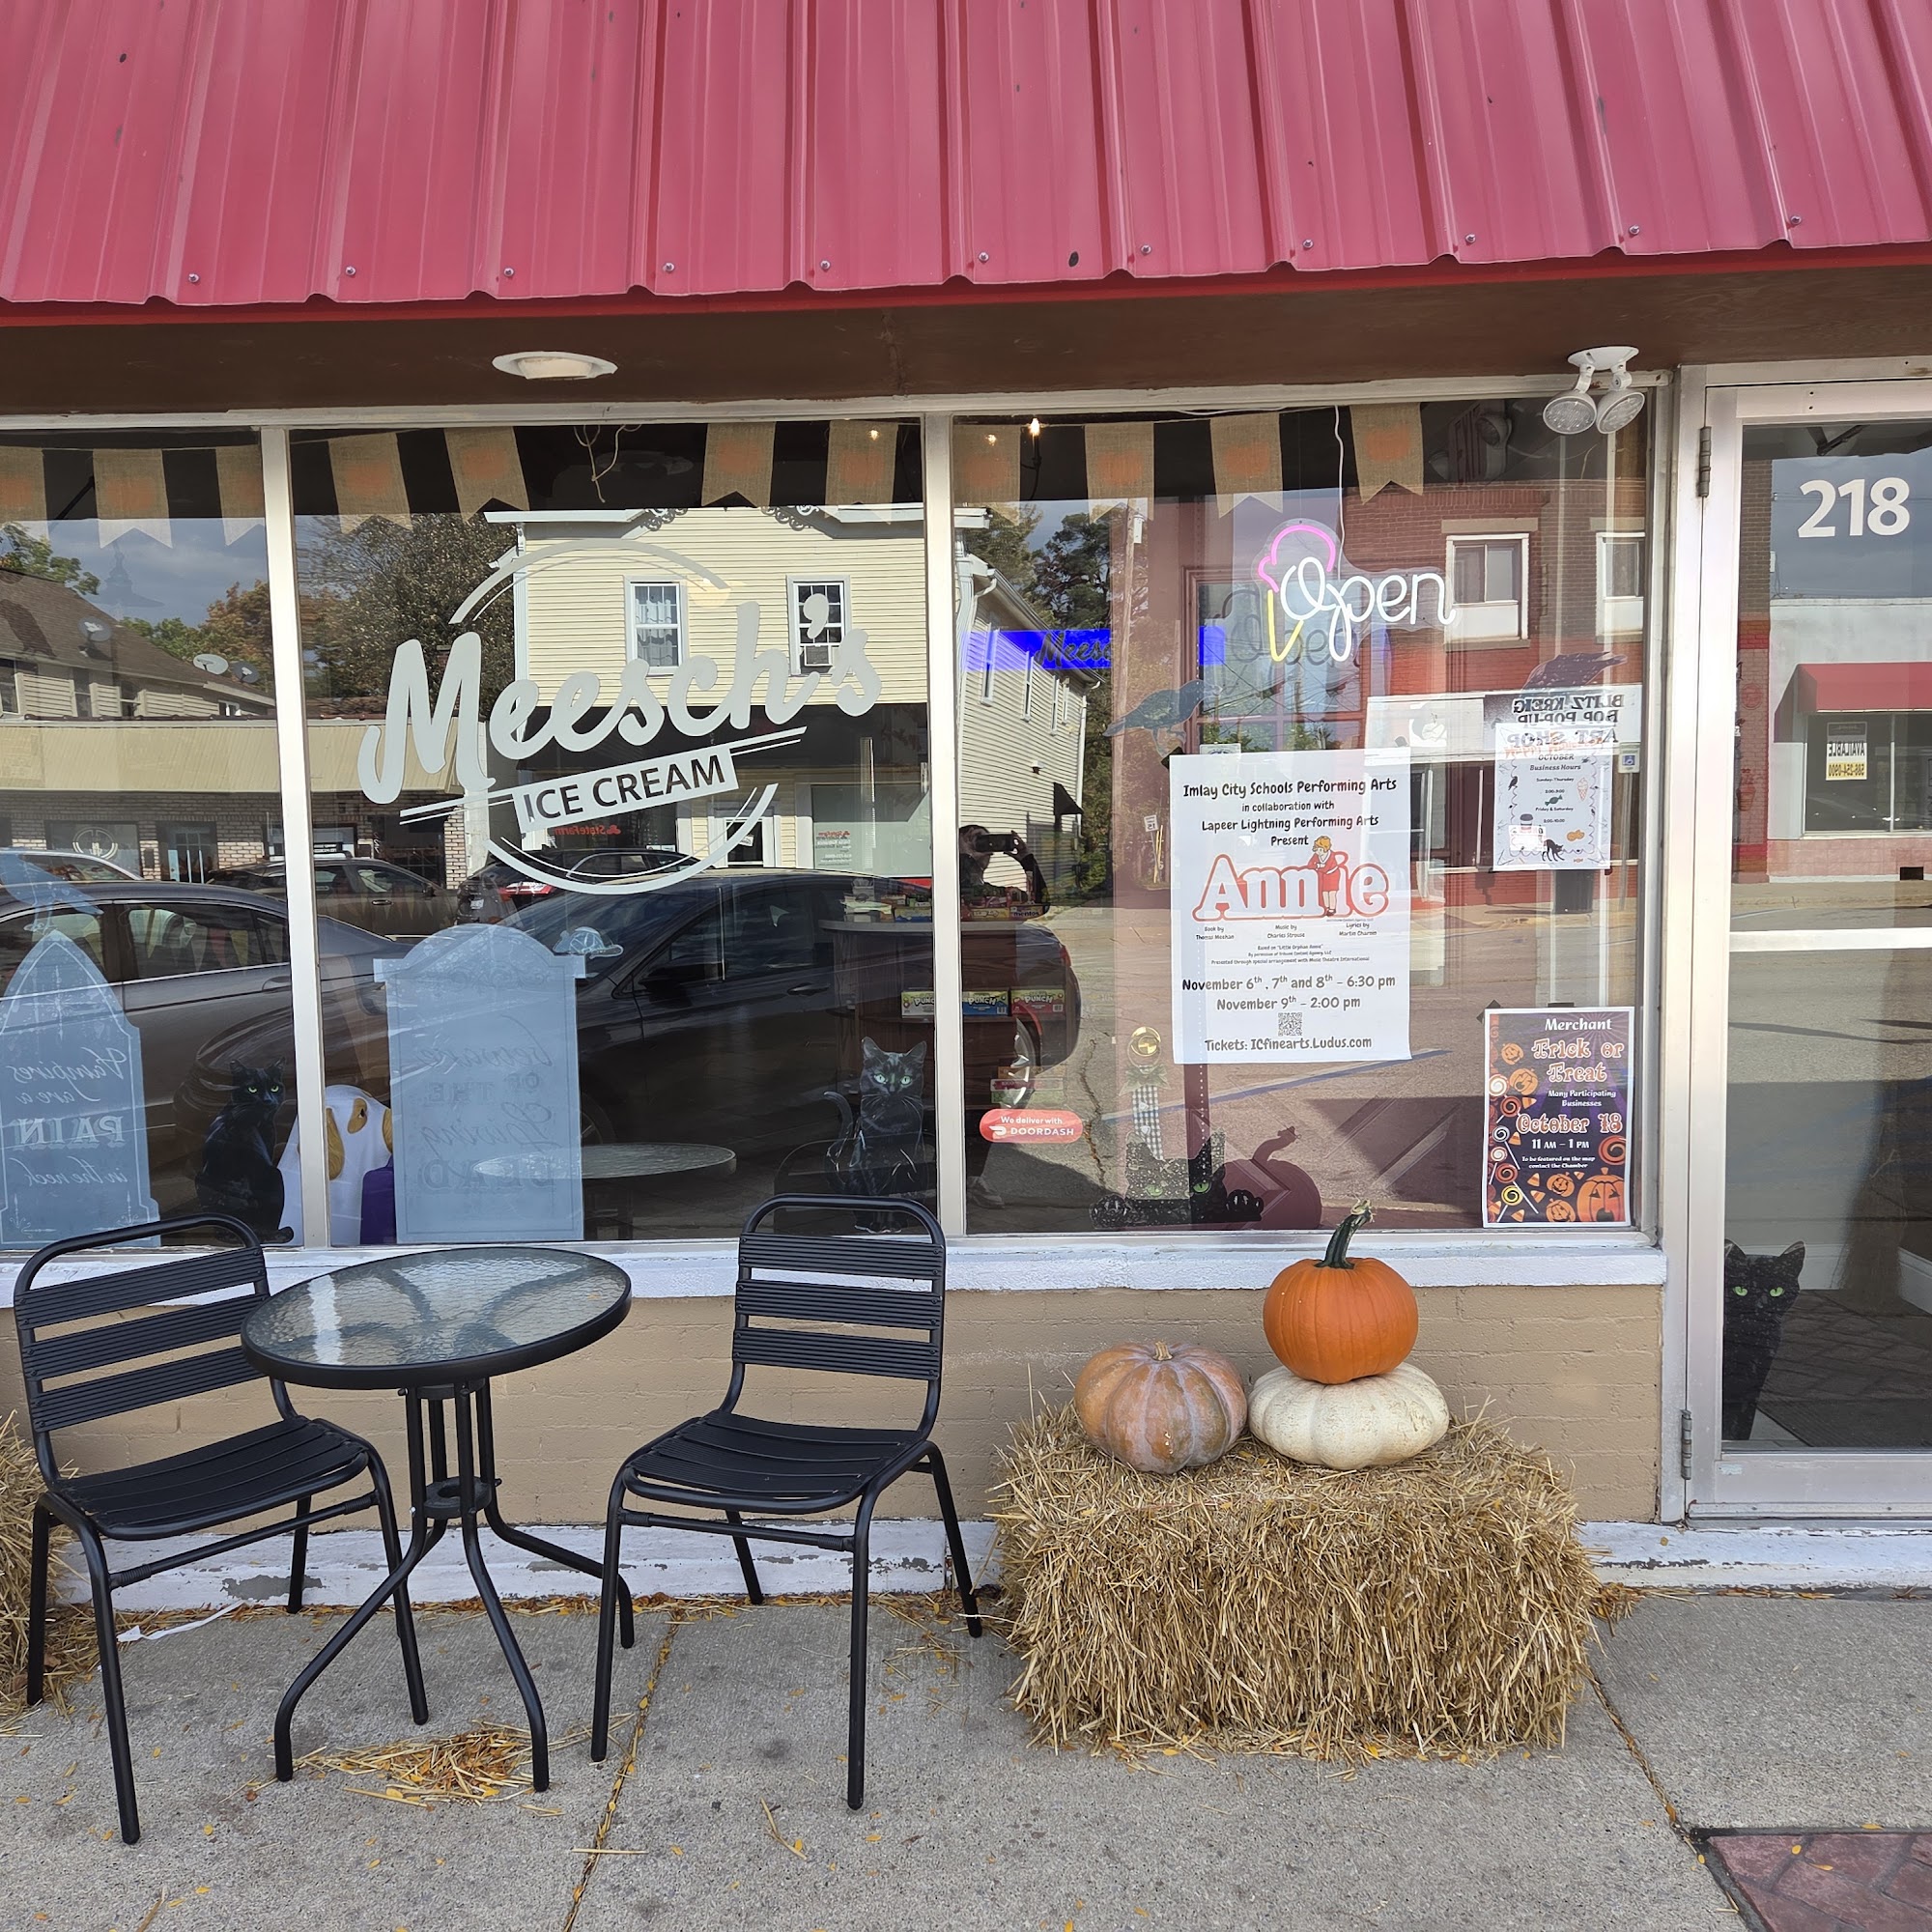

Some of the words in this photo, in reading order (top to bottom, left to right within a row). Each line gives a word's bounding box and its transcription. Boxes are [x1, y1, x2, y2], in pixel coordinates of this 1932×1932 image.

[1797, 476, 1911, 538] 218
[1280, 555, 1457, 663] Open
[357, 593, 882, 806] Meesch's
[523, 785, 582, 822] ICE
[591, 753, 726, 810] CREAM
[1183, 783, 1218, 800] Imlay
[1222, 782, 1247, 799] City
[1250, 781, 1293, 795] Schools
[1297, 780, 1366, 796] Performing
[1370, 778, 1397, 790] Arts
[1241, 803, 1250, 812] in
[1252, 801, 1311, 812] collaboration
[1313, 800, 1335, 811] with
[1202, 820, 1238, 833] Lapeer
[1241, 818, 1291, 833] Lightning
[1294, 816, 1353, 831] Performing
[1356, 815, 1379, 826] Arts
[1270, 835, 1309, 846] Present
[1191, 850, 1390, 923] Annie
[1182, 979, 1243, 991] November
[1272, 976, 1288, 989] 7th
[1291, 976, 1312, 988] and
[1316, 974, 1333, 988] 8th
[1347, 976, 1375, 988] 6:30
[1378, 977, 1396, 990] pm
[914, 997, 935, 1006] PUNC
[968, 996, 997, 1006] PUNCH
[1024, 995, 1053, 1004] PUNCH
[1217, 998, 1278, 1010] November
[1281, 995, 1297, 1009] 9th
[1310, 996, 1340, 1009] 2:00
[1344, 998, 1361, 1011] pm
[1545, 1018, 1612, 1031] Merchant
[1205, 1038, 1248, 1052] Tickets:
[1250, 1037, 1372, 1051] ICfinearts.Ludus.com
[1531, 1037, 1592, 1059] Trick
[1600, 1041, 1625, 1059] or
[1547, 1061, 1608, 1083] Treat
[1548, 1090, 1568, 1099] Many
[1569, 1089, 1617, 1098] Participating
[1516, 1113, 1590, 1134] October
[1598, 1112, 1623, 1134] 18
[1010, 1128, 1074, 1136] DOORDASH
[1532, 1139, 1541, 1149] 11
[1569, 1139, 1574, 1149] 1
